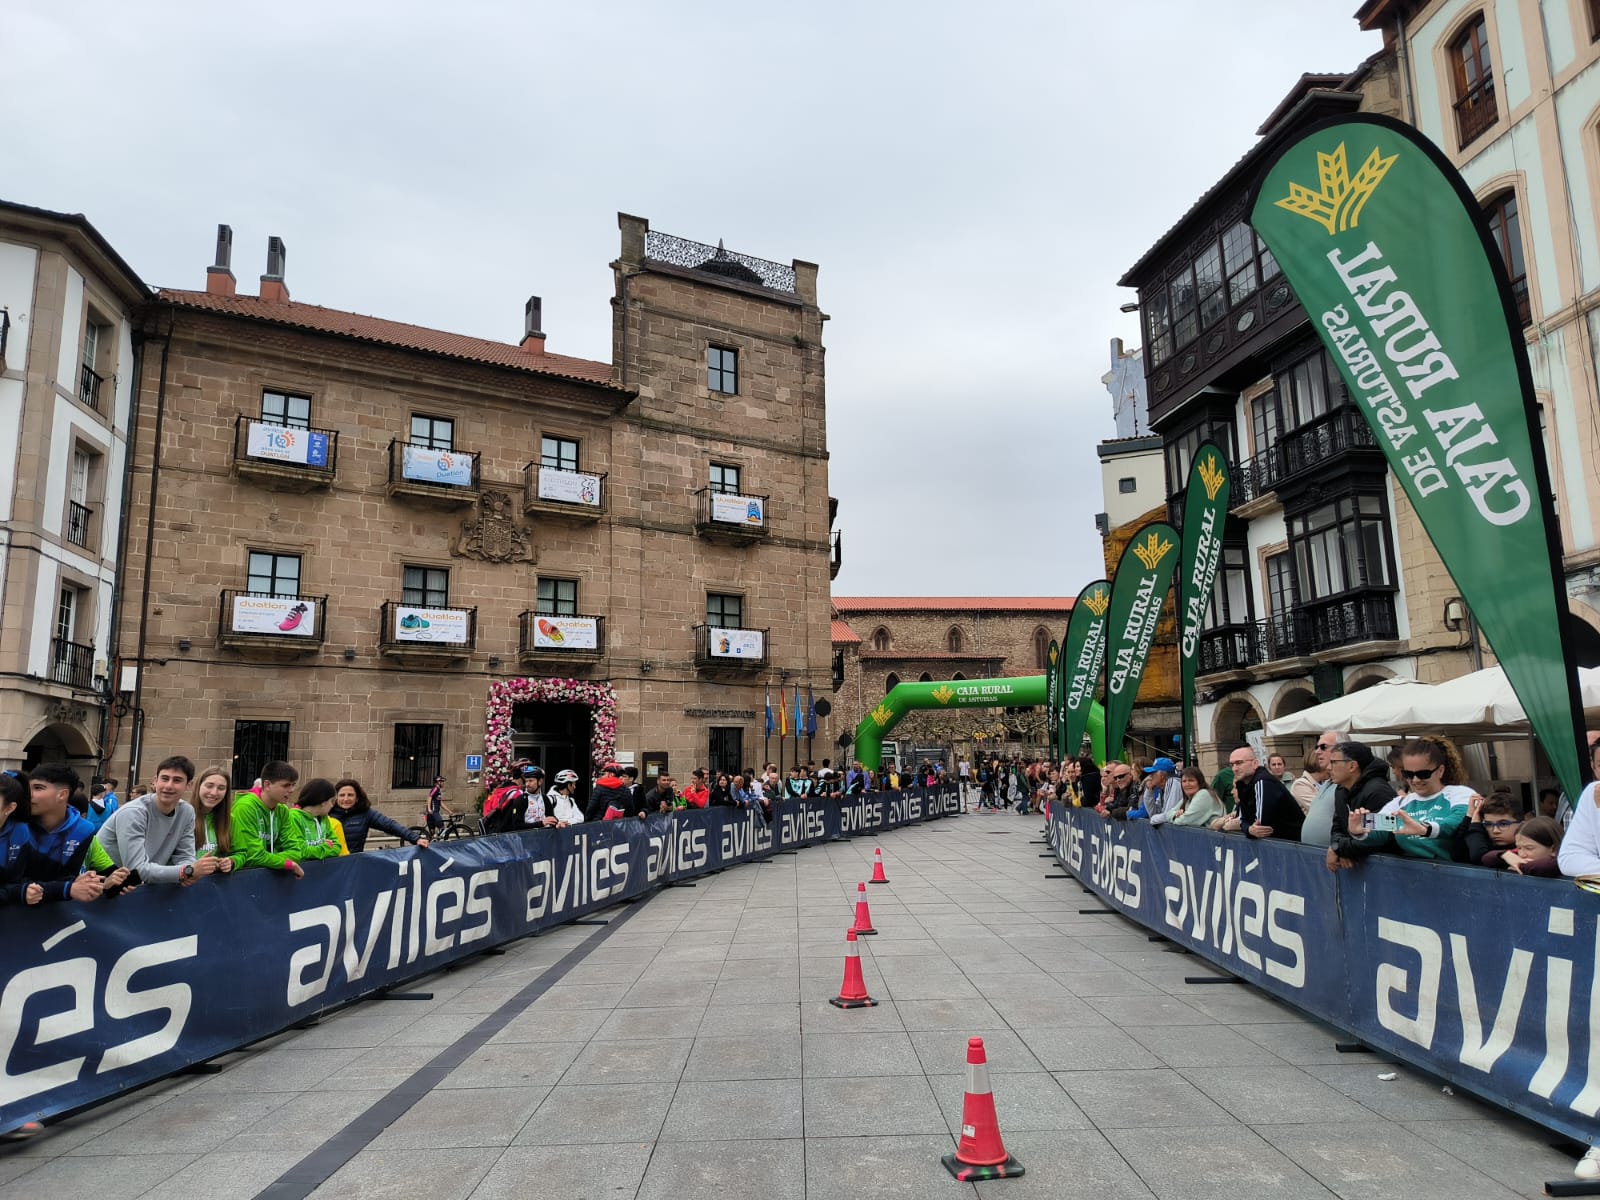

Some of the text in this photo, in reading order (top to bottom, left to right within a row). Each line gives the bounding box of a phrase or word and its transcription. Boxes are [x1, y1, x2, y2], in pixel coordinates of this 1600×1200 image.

[1182, 507, 1216, 658] CAJA RURAL
[1199, 537, 1221, 617] ASTURIAS
[1068, 619, 1104, 710] CAJA RURAL
[1084, 635, 1106, 698] DE ASTURIAS
[1110, 574, 1158, 694] CAJA RURAL
[1130, 596, 1162, 679] DE ASTURIAS
[957, 685, 1014, 695] CAJA RURAL
[781, 803, 825, 844] avilés
[840, 797, 883, 832] avilés
[287, 856, 499, 1007] avilés
[1165, 846, 1306, 989] avilés
